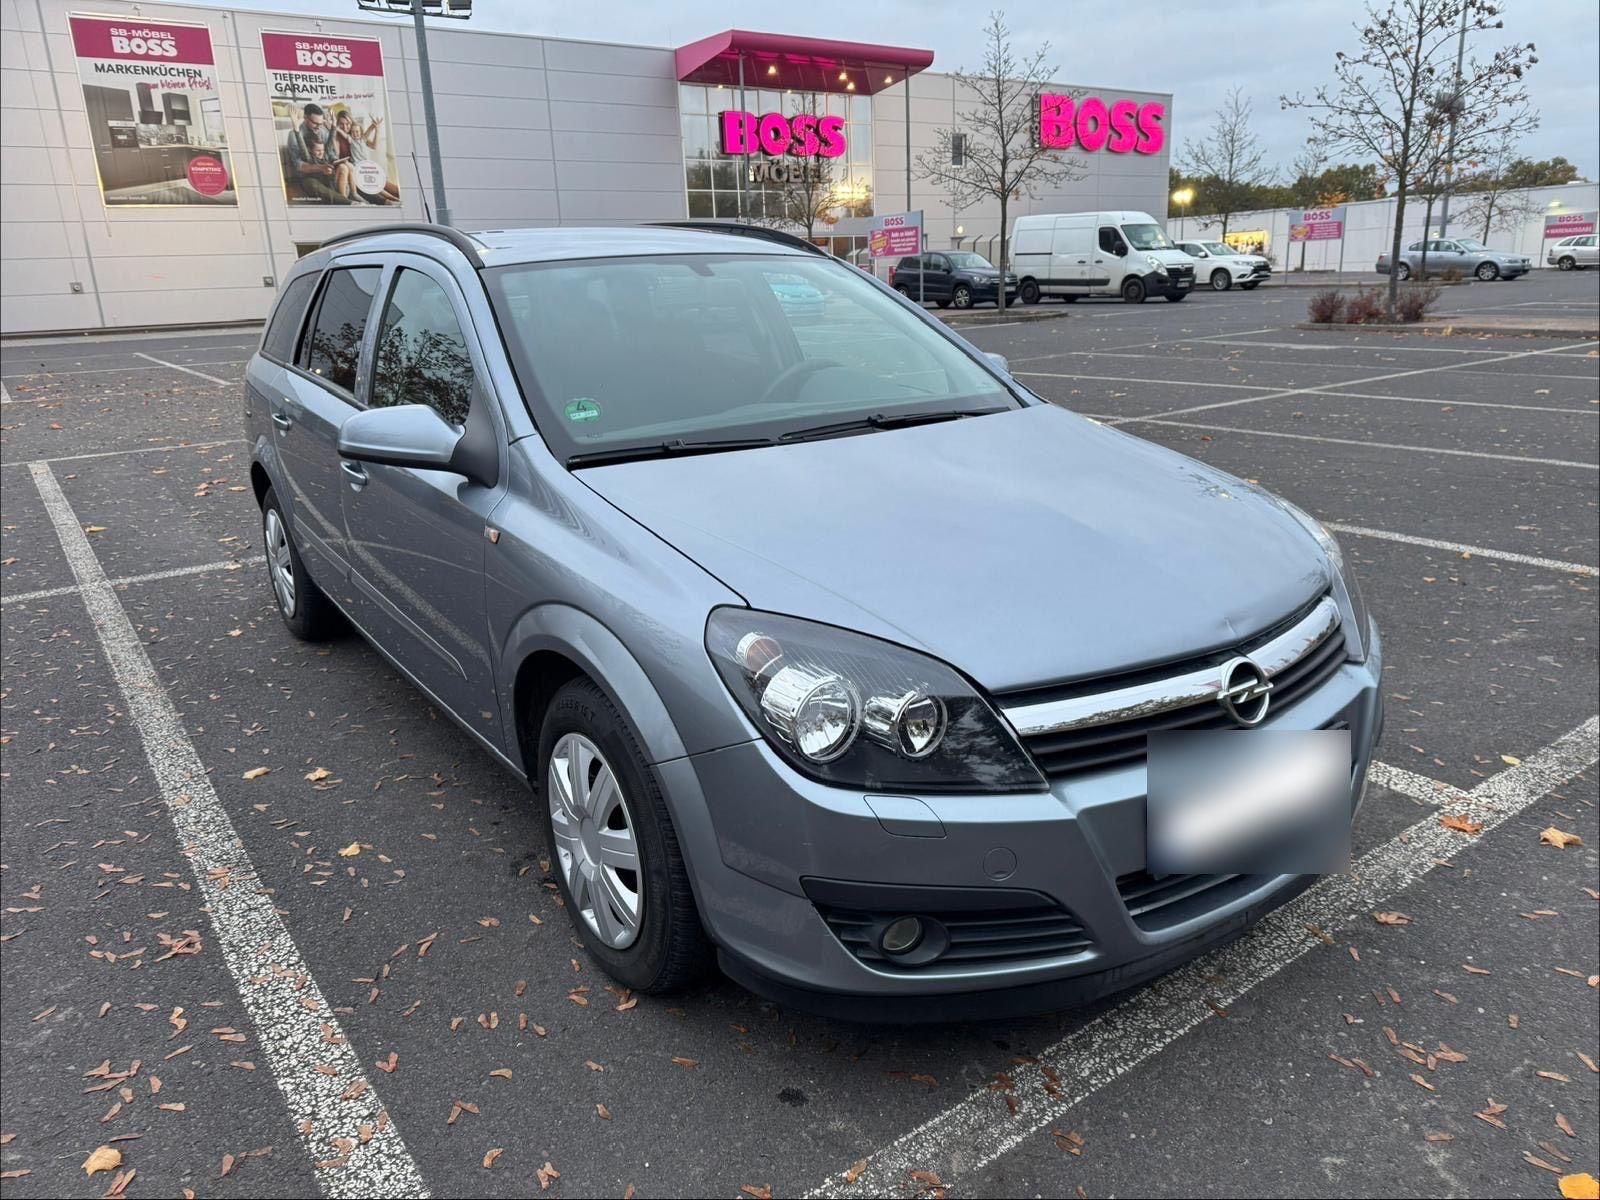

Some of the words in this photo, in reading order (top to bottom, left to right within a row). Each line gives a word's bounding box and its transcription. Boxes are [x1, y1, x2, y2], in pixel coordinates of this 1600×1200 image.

[109, 27, 176, 40] SB-MÖBEL
[111, 36, 178, 57] BOSS
[295, 41, 351, 53] SB-MÖBEL
[296, 49, 353, 69] BOSS
[94, 62, 202, 79] MARKENKÜCHEN
[272, 72, 329, 83] TIEFPREIS-
[274, 82, 337, 95] GARANTIE
[1040, 92, 1166, 156] BOSS
[720, 110, 848, 158] BOSS
[884, 216, 905, 227] BOSS
[1303, 210, 1332, 221] BOSS
[1558, 214, 1584, 223] BOSS
[576, 401, 587, 411] 4
